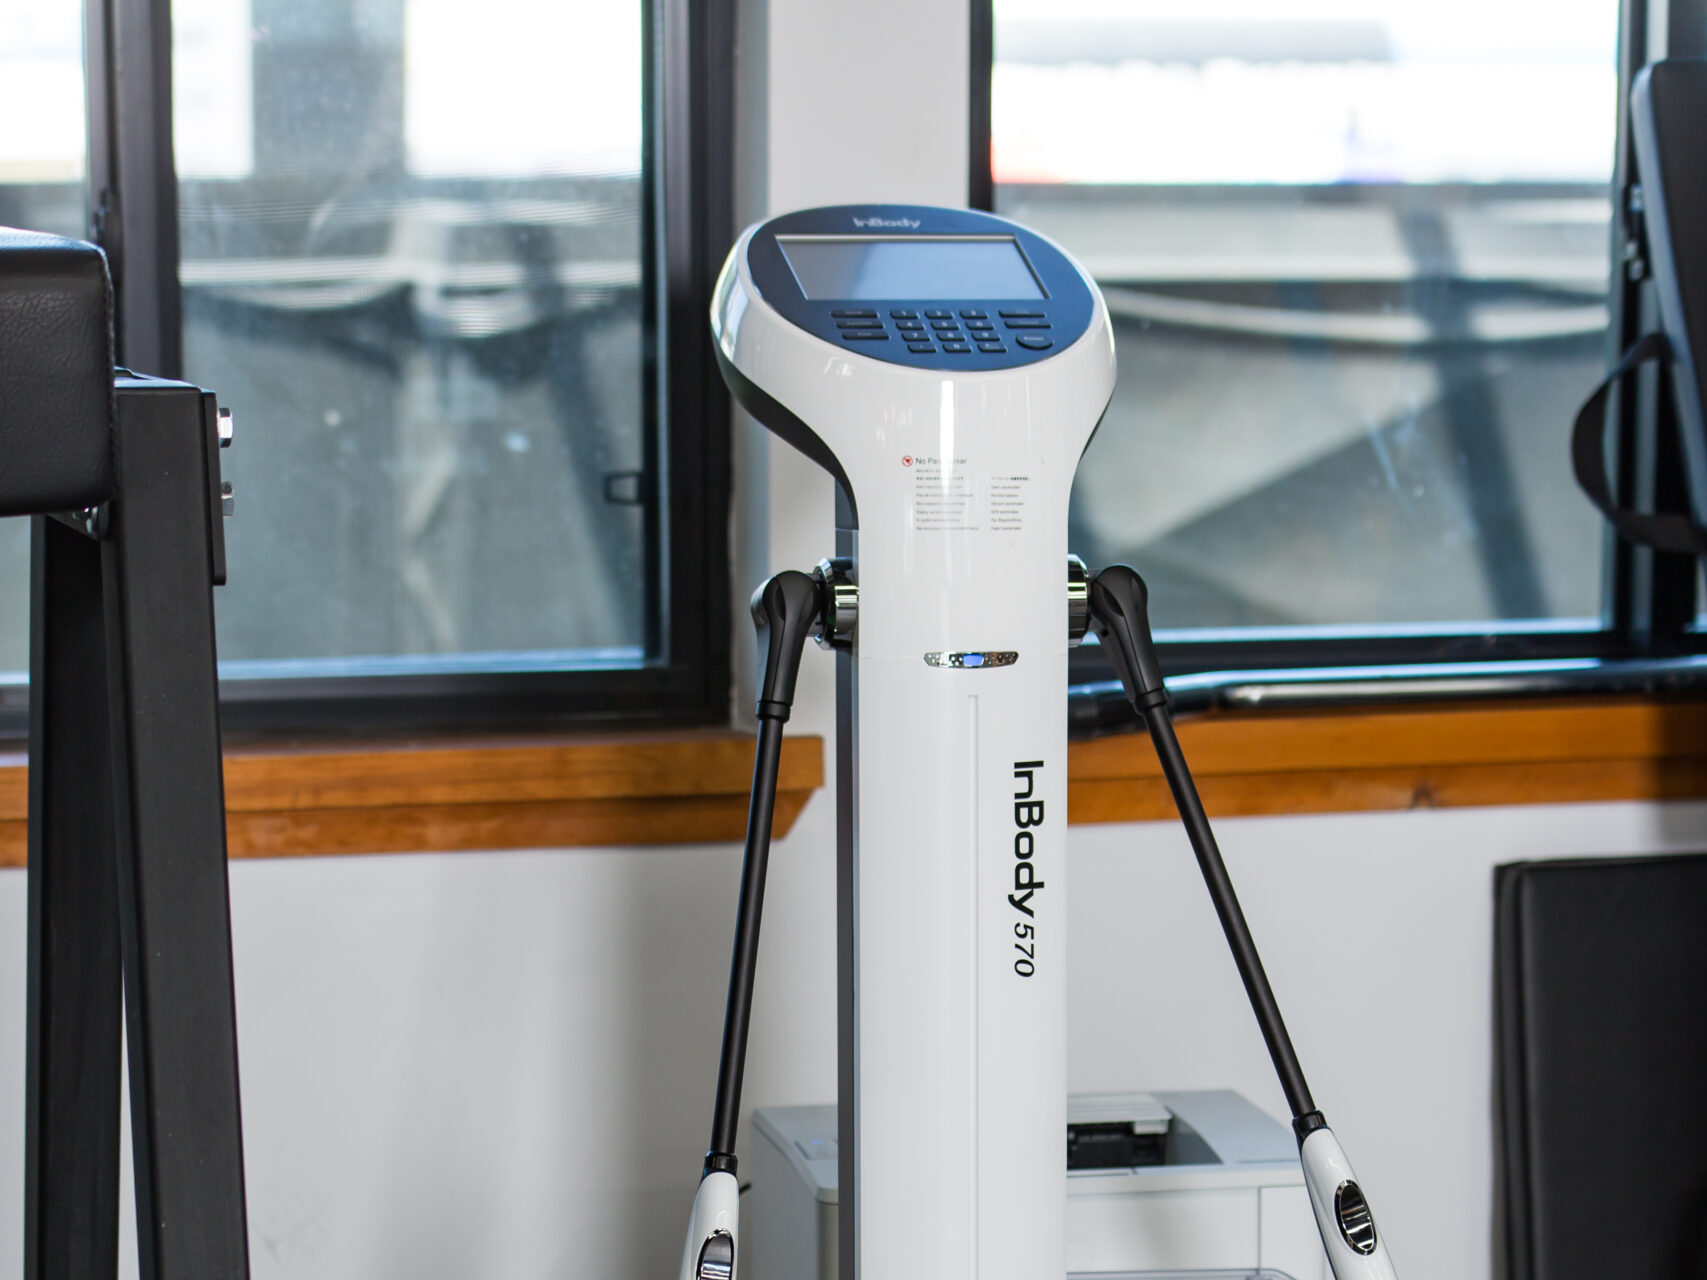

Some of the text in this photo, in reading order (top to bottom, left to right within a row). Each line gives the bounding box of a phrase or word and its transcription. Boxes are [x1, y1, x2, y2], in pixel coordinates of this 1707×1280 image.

[852, 216, 921, 229] InBody
[915, 457, 967, 465] No Paker
[1007, 760, 1045, 978] InBody 570
